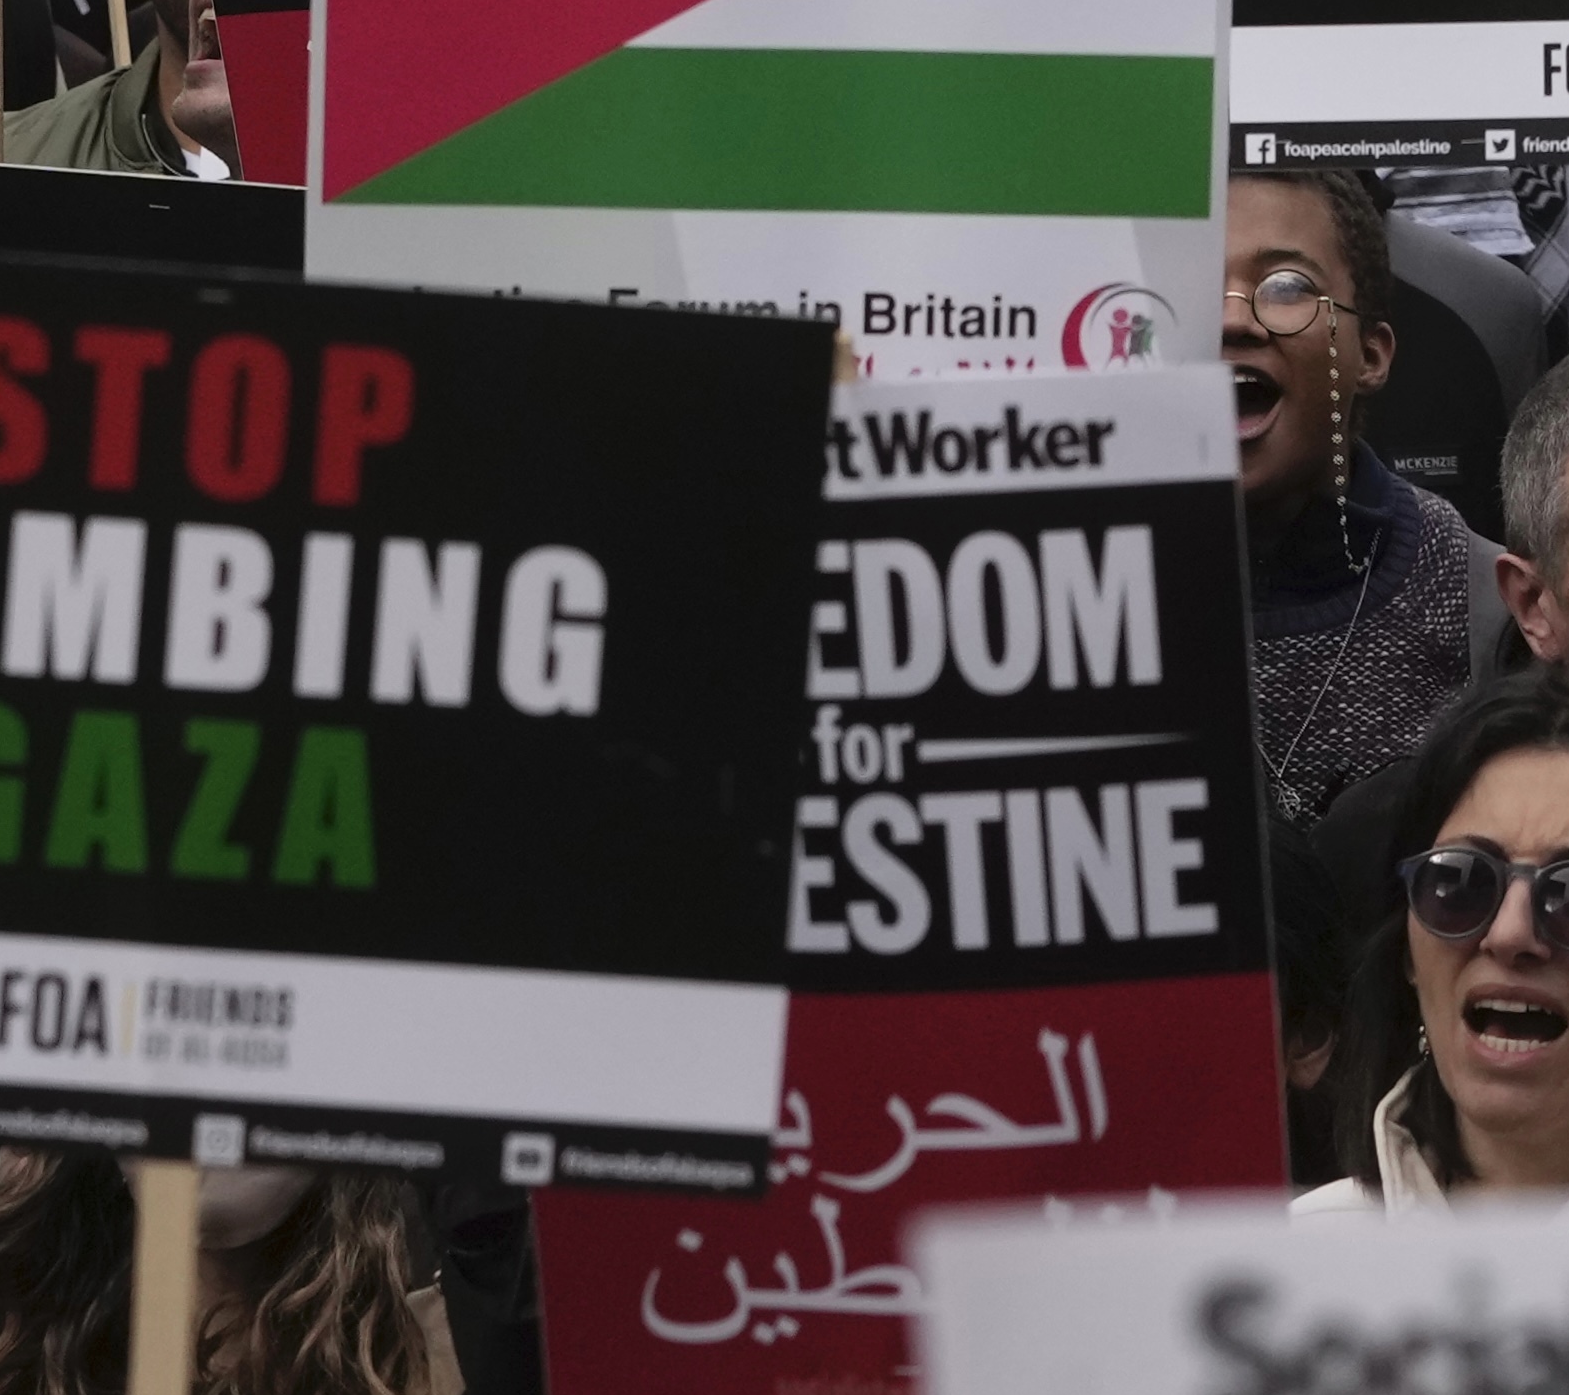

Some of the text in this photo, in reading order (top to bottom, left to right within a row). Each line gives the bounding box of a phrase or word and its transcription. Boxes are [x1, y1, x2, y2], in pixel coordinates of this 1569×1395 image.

[1284, 135, 1451, 162] foapeaceinpalestine
[862, 294, 1039, 341] Britain
[866, 407, 1113, 480] Worker
[1394, 456, 1457, 470] MCKENZIE
[813, 703, 913, 786] for
[786, 778, 1220, 955] ESTINE
[143, 975, 294, 1033] FRIENDS
